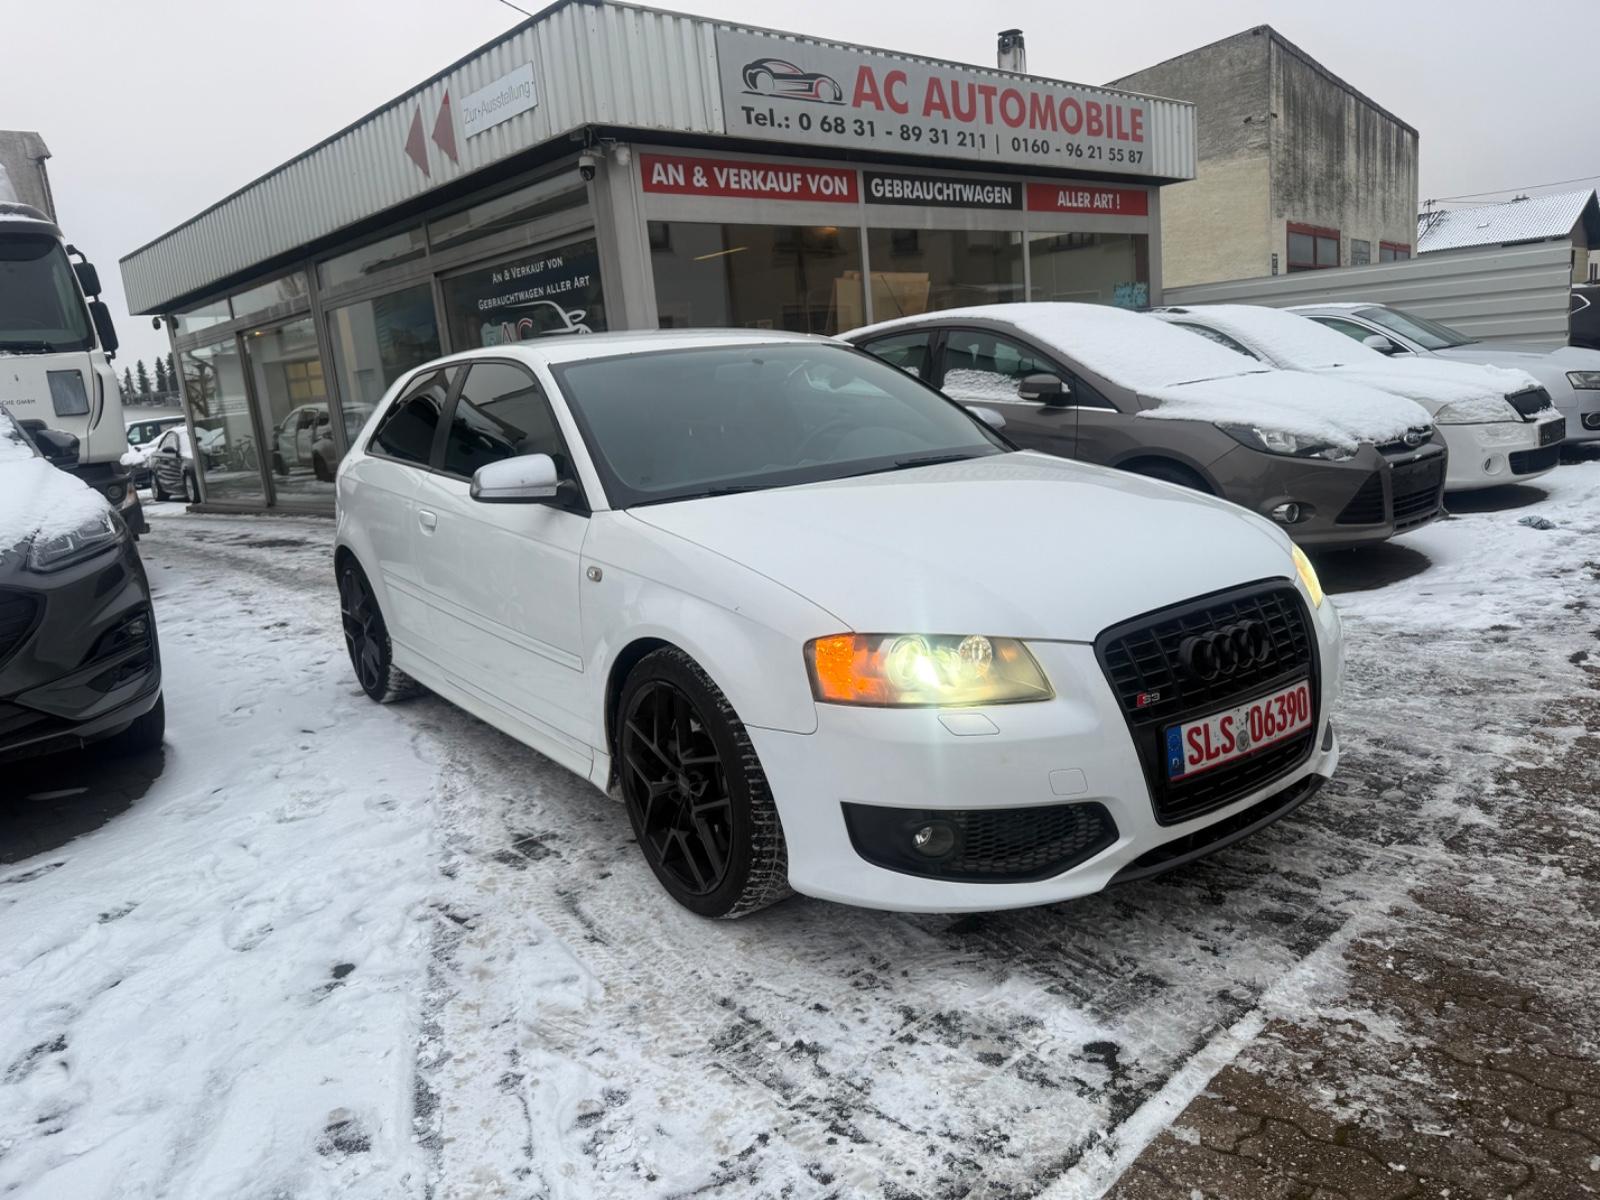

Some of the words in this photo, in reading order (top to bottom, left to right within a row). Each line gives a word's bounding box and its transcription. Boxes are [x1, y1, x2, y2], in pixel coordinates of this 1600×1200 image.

[852, 65, 908, 114] AC
[922, 76, 1144, 142] AUTOMOBILE
[741, 106, 790, 129] Tel.:
[799, 113, 811, 131] 0
[820, 115, 846, 134] 68
[853, 119, 875, 137] 31
[900, 124, 922, 142] 89
[929, 128, 948, 145] 31
[957, 131, 986, 149] 211
[1012, 137, 1049, 154] 0160
[1066, 142, 1083, 158] 96
[1088, 145, 1102, 160] 21
[1109, 148, 1124, 162] 55
[1128, 150, 1143, 164] 87
[652, 163, 685, 186] AN
[693, 166, 708, 188] &
[713, 166, 802, 193] VERKAUF
[807, 174, 848, 195] VON
[871, 178, 1012, 204] GEBRAUCHTWAGEN
[1057, 191, 1090, 208] ALLER
[1093, 194, 1113, 209] ART
[504, 270, 510, 280] &
[546, 257, 563, 270] VON
[1187, 716, 1235, 765] SLS
[1250, 686, 1308, 742] 06390
